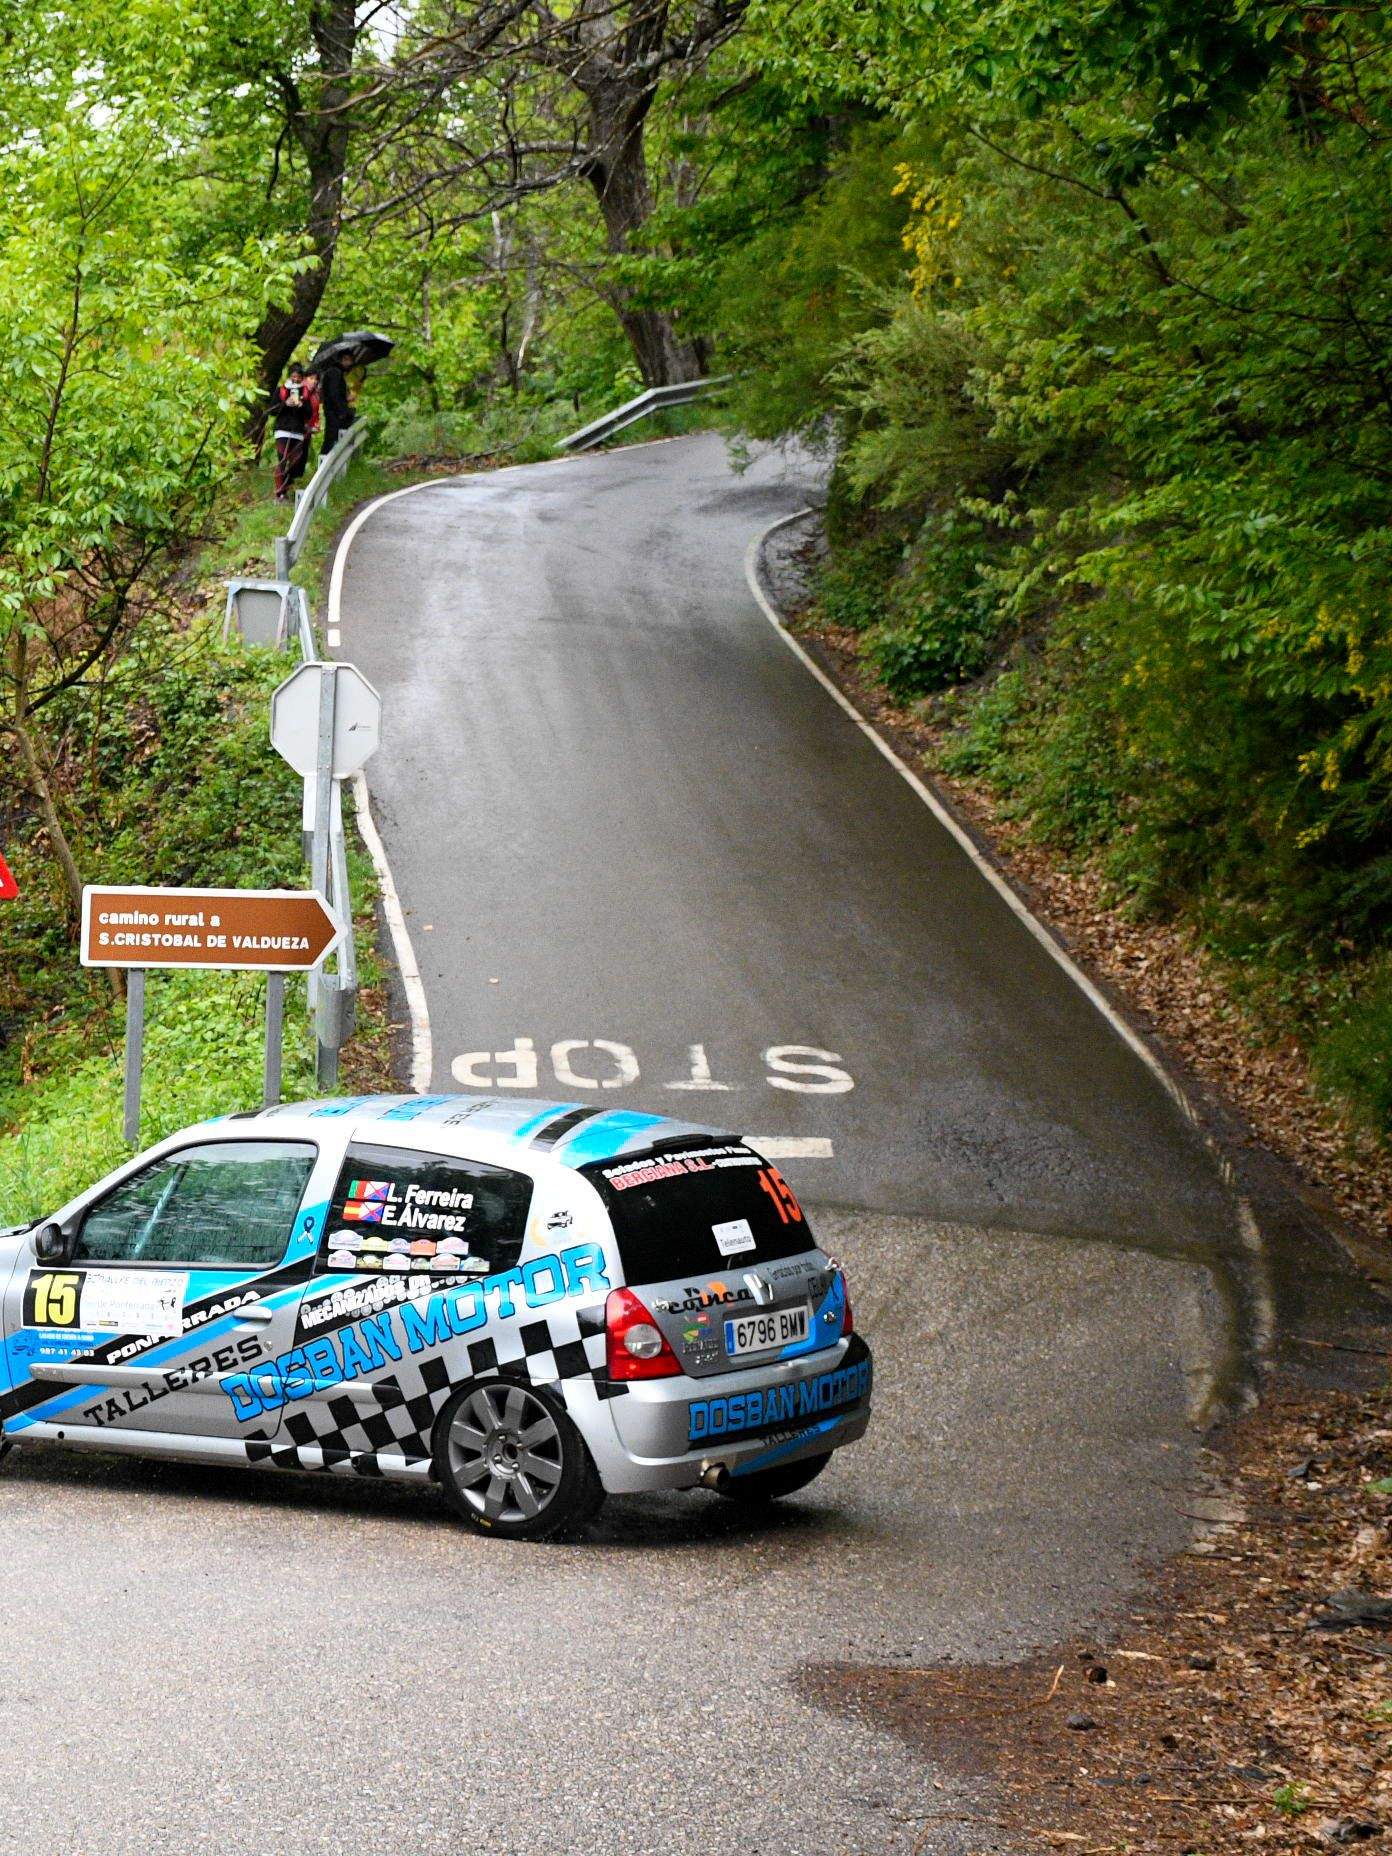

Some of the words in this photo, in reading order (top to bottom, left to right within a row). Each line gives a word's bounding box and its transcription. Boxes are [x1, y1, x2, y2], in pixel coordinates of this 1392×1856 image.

[98, 910, 159, 926] camino
[164, 911, 204, 927] rural
[210, 915, 220, 927] a
[98, 932, 201, 948] S.CRISTOBAL
[207, 935, 226, 948] DE
[232, 935, 309, 950] VALDUEZA
[451, 1037, 855, 1094] STOP
[387, 1182, 402, 1203] L.
[405, 1184, 474, 1209] Ferreira
[758, 1167, 802, 1224] 15
[30, 1273, 80, 1325] 15
[83, 1335, 263, 1426] TALLERES
[219, 1312, 402, 1422] DOSBAN
[399, 1242, 611, 1355] MOTOR
[737, 1317, 776, 1348] 6796
[780, 1311, 805, 1339] BMW
[688, 1383, 796, 1441] DOSBAN
